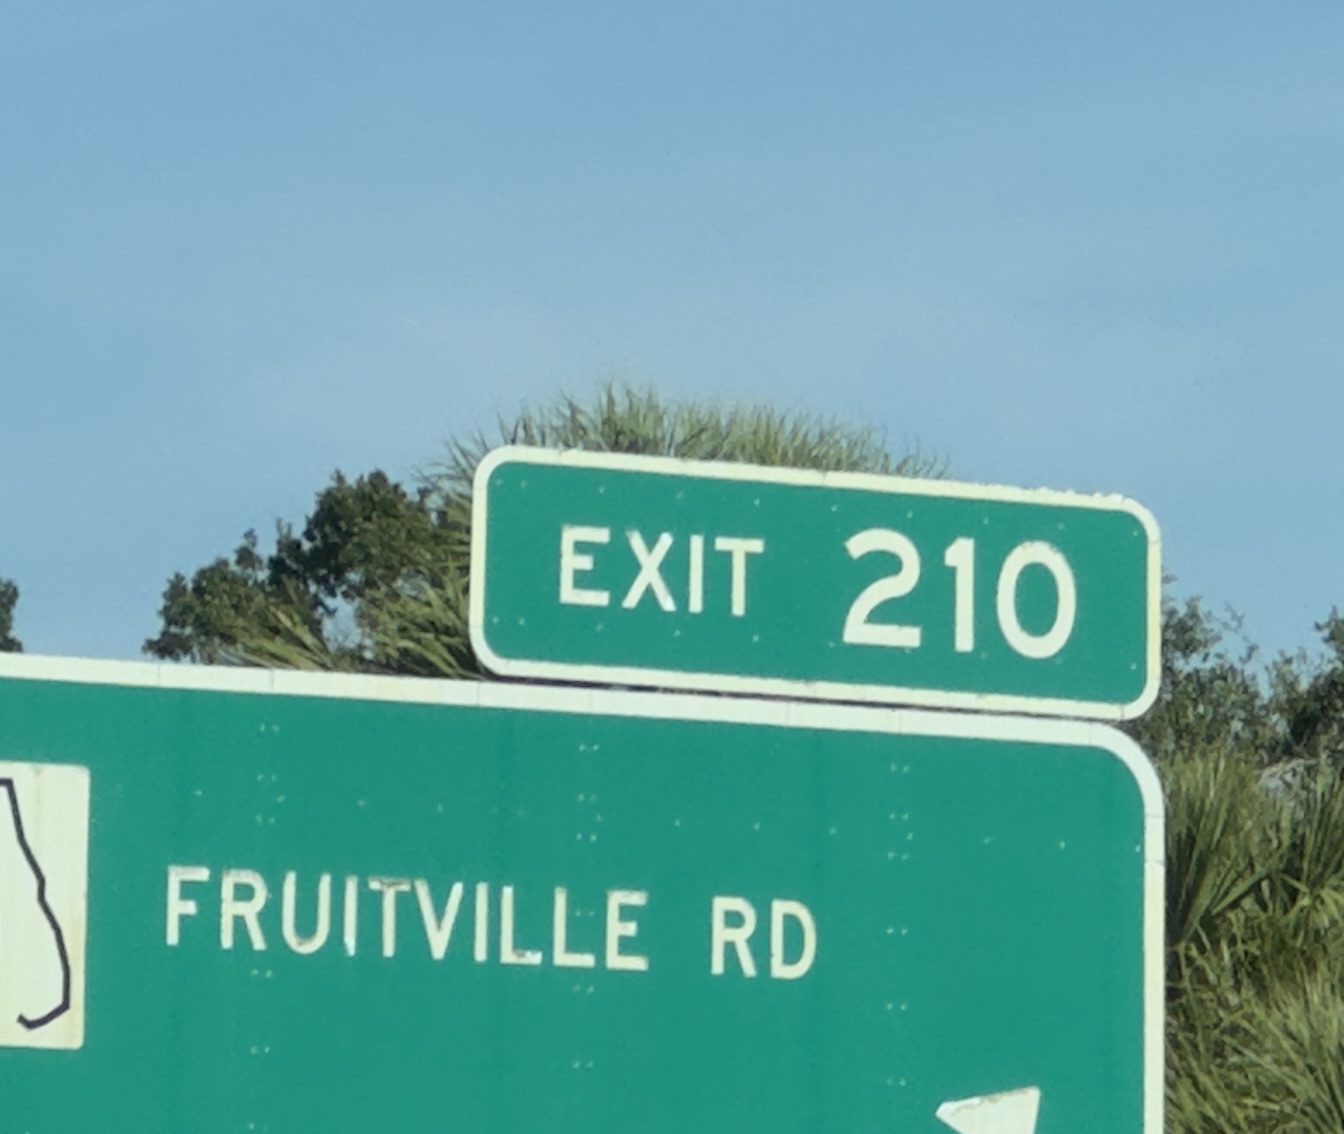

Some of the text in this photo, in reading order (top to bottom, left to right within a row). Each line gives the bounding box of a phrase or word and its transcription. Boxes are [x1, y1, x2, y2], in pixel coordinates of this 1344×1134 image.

[559, 525, 1077, 659] EXIT 210
[166, 865, 818, 981] FRUITVILLE RD
